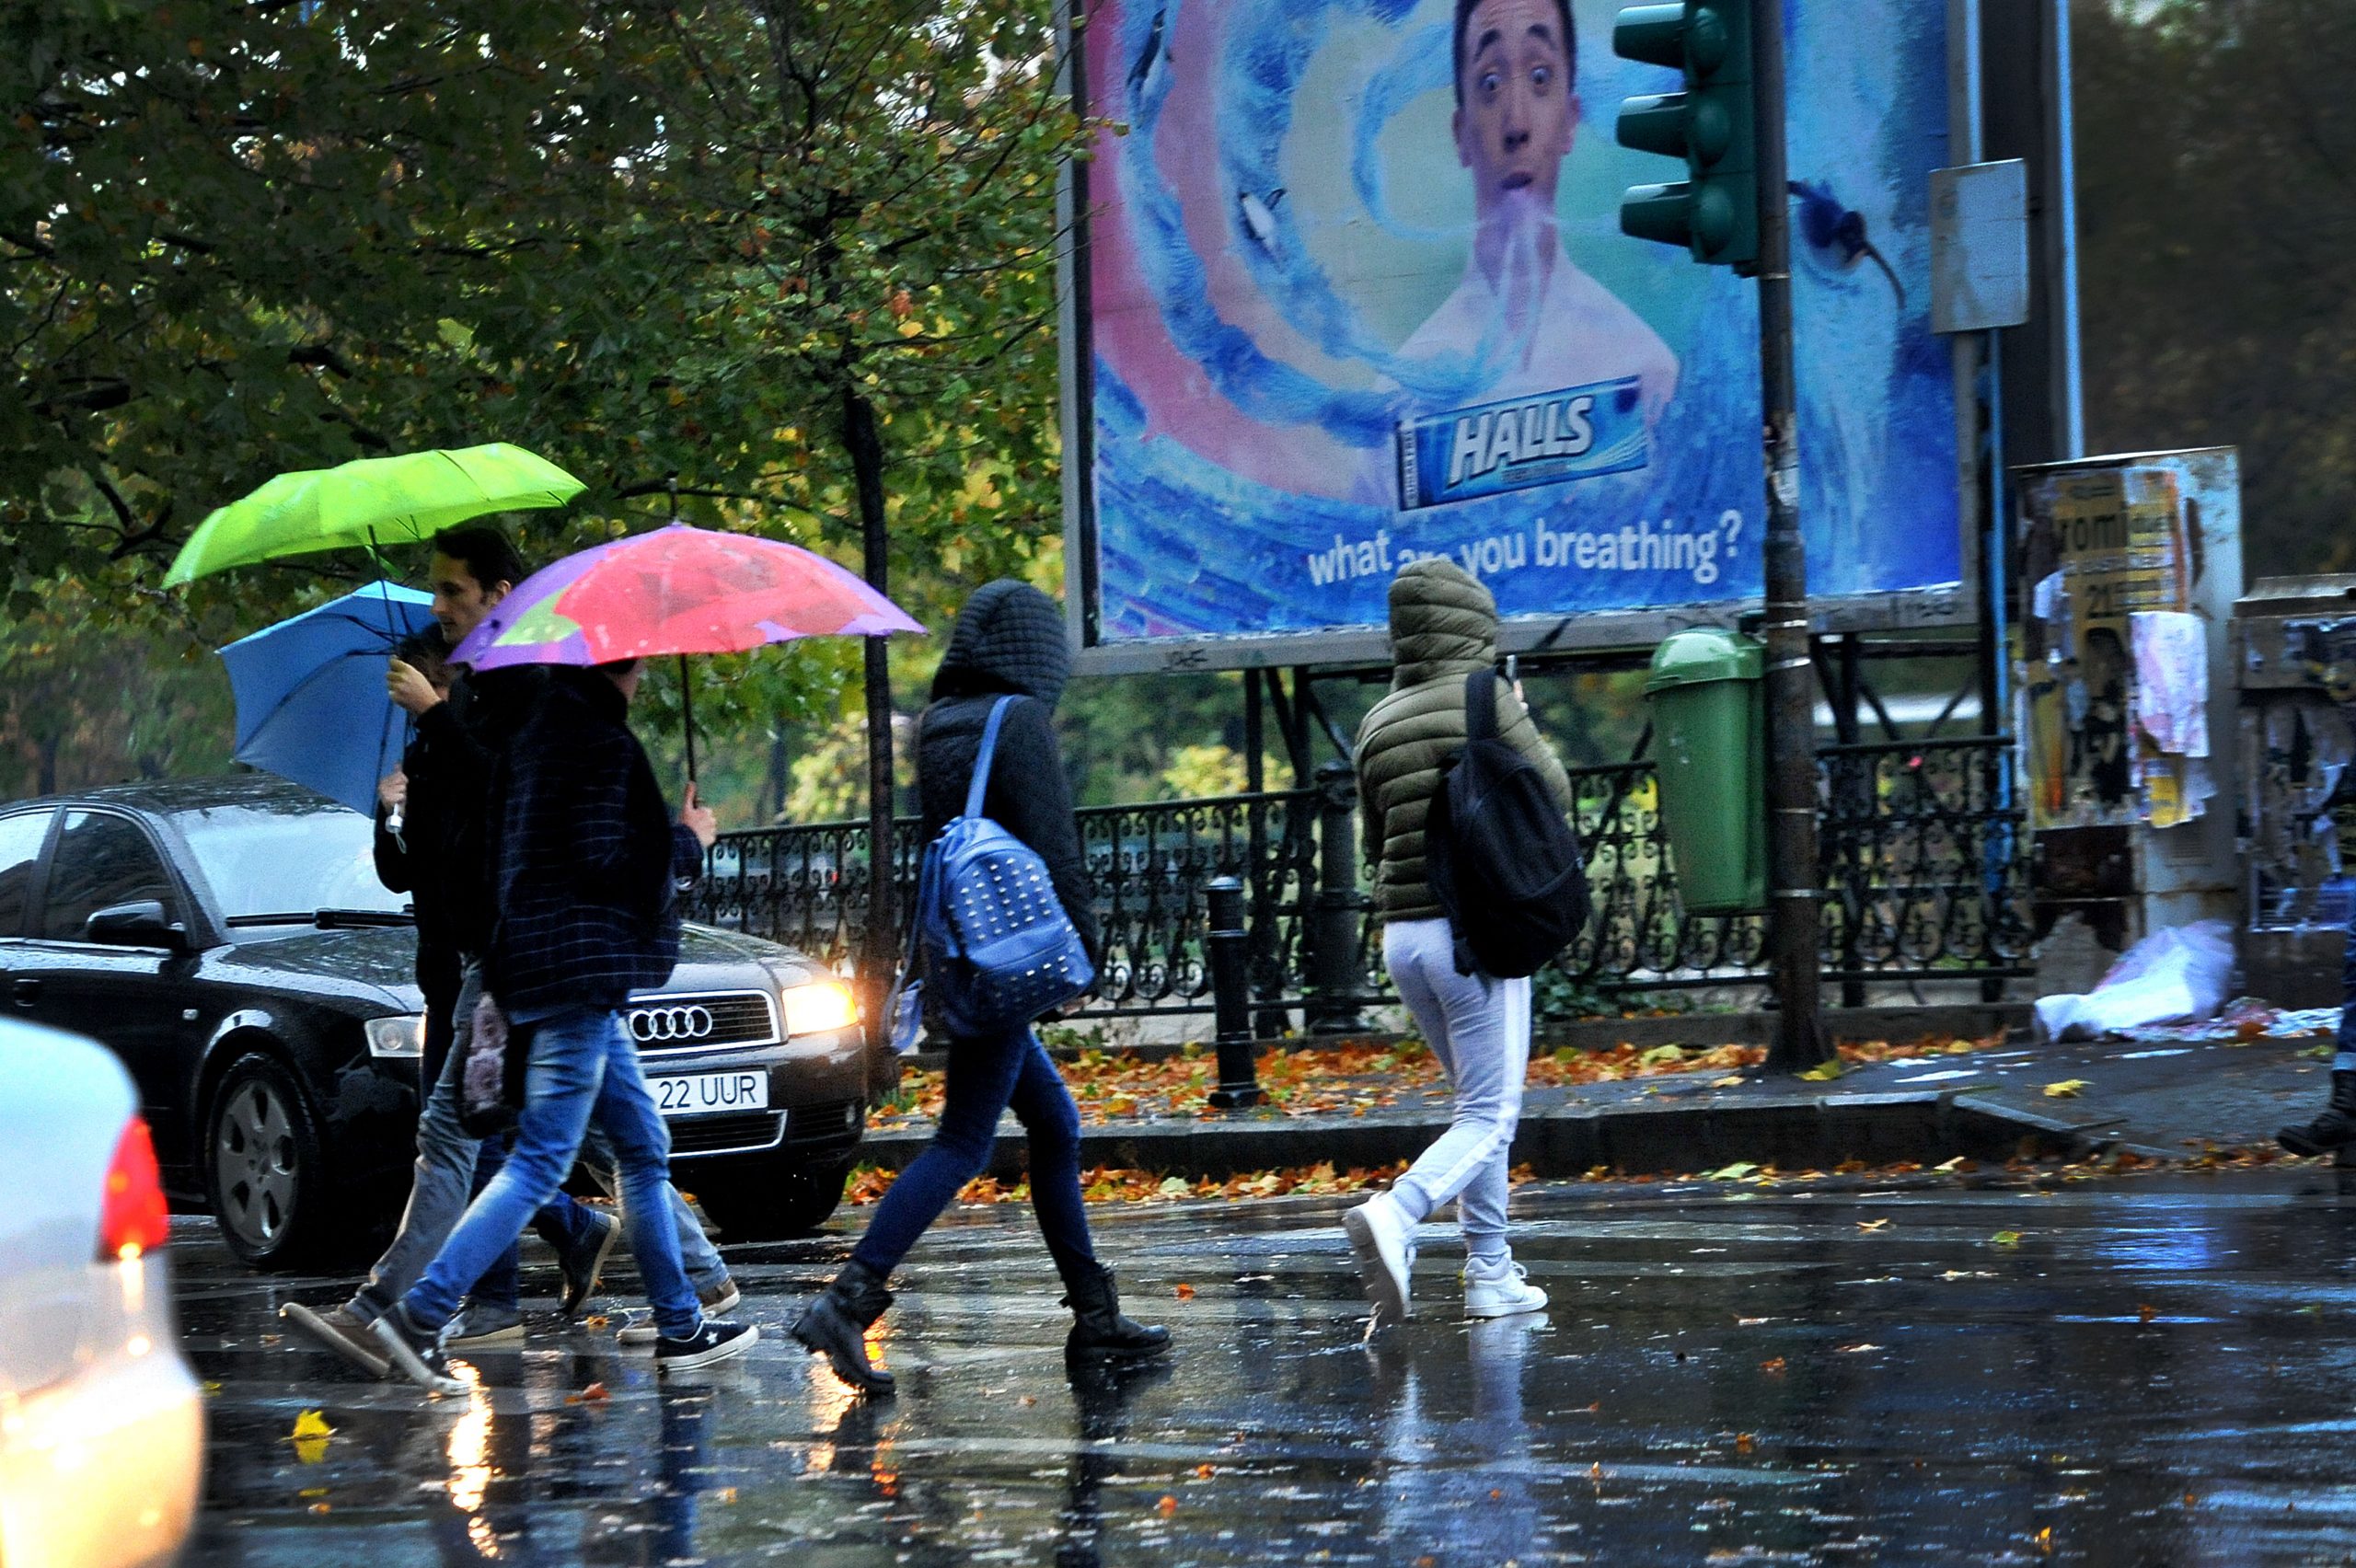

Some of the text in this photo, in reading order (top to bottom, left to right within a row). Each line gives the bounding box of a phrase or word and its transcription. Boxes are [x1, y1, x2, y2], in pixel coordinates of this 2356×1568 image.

[1446, 395, 1594, 489] HALLS
[1308, 509, 1742, 586] what you breathing?
[658, 1075, 756, 1109] 22 UUR
